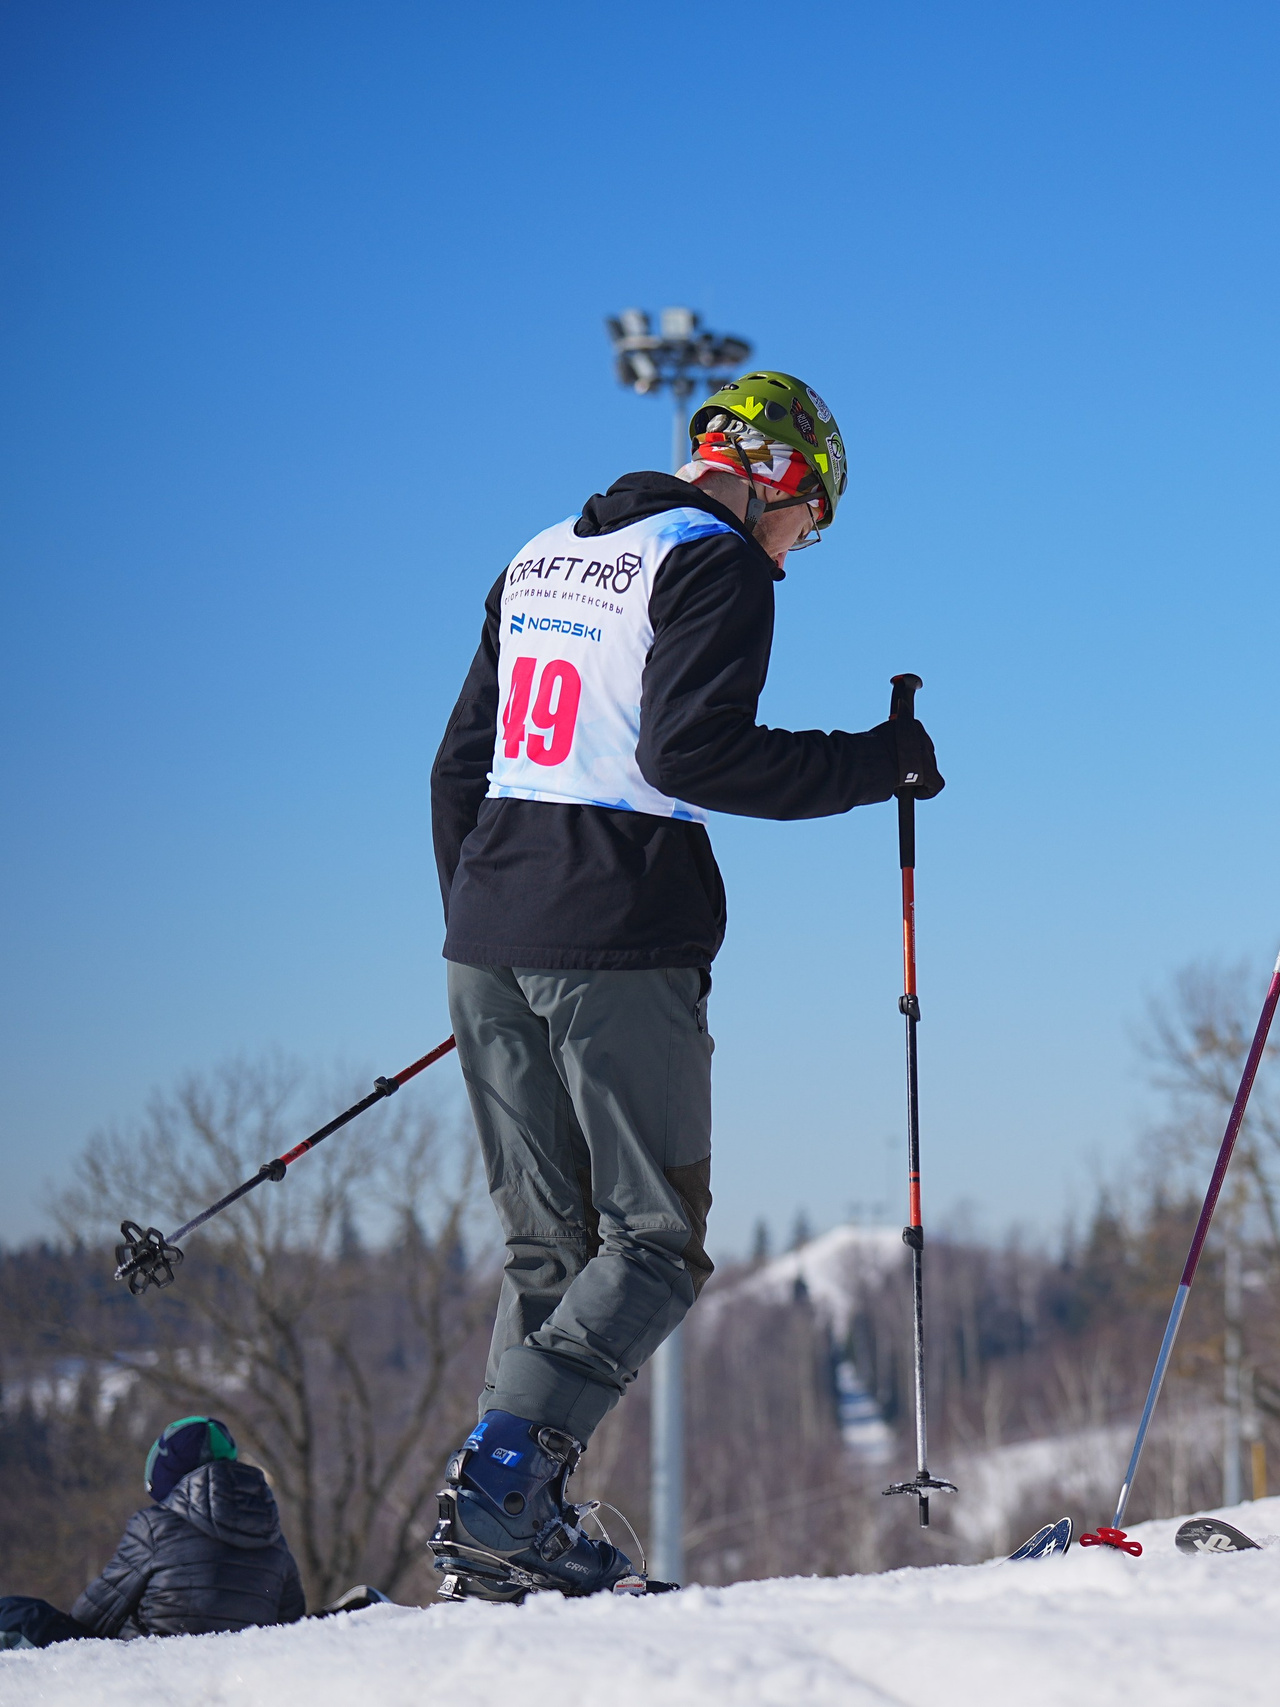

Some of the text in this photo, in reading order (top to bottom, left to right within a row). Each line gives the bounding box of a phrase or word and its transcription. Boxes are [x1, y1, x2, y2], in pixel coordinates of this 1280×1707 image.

[509, 556, 632, 594] CRAFT PRO
[561, 591, 624, 615] ИНТЕНСИВЫ
[527, 616, 602, 642] NORDSKI
[502, 656, 582, 767] 49
[1193, 1534, 1238, 1553] K2
